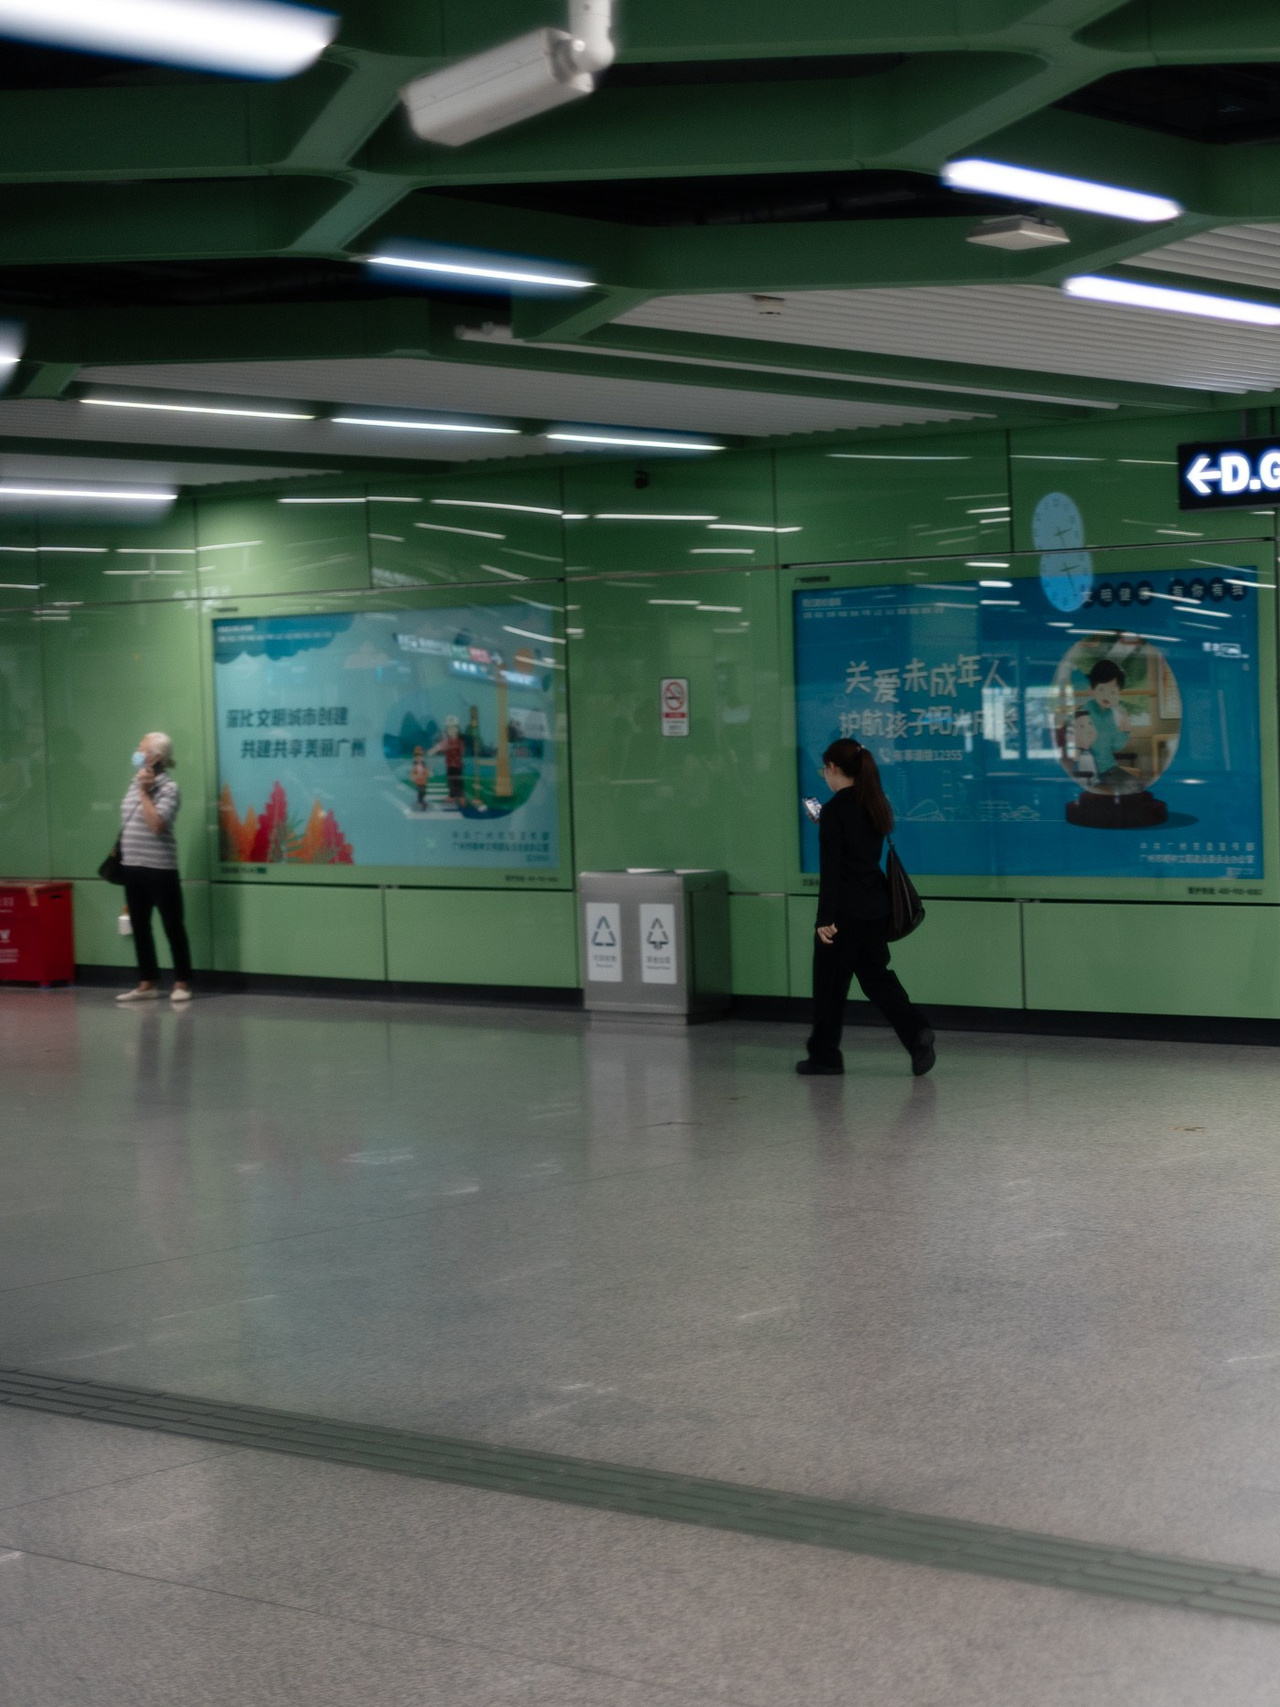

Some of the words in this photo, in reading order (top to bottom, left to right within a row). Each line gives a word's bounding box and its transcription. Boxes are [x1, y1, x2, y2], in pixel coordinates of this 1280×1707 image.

[845, 653, 1008, 703] 关爱未成年人
